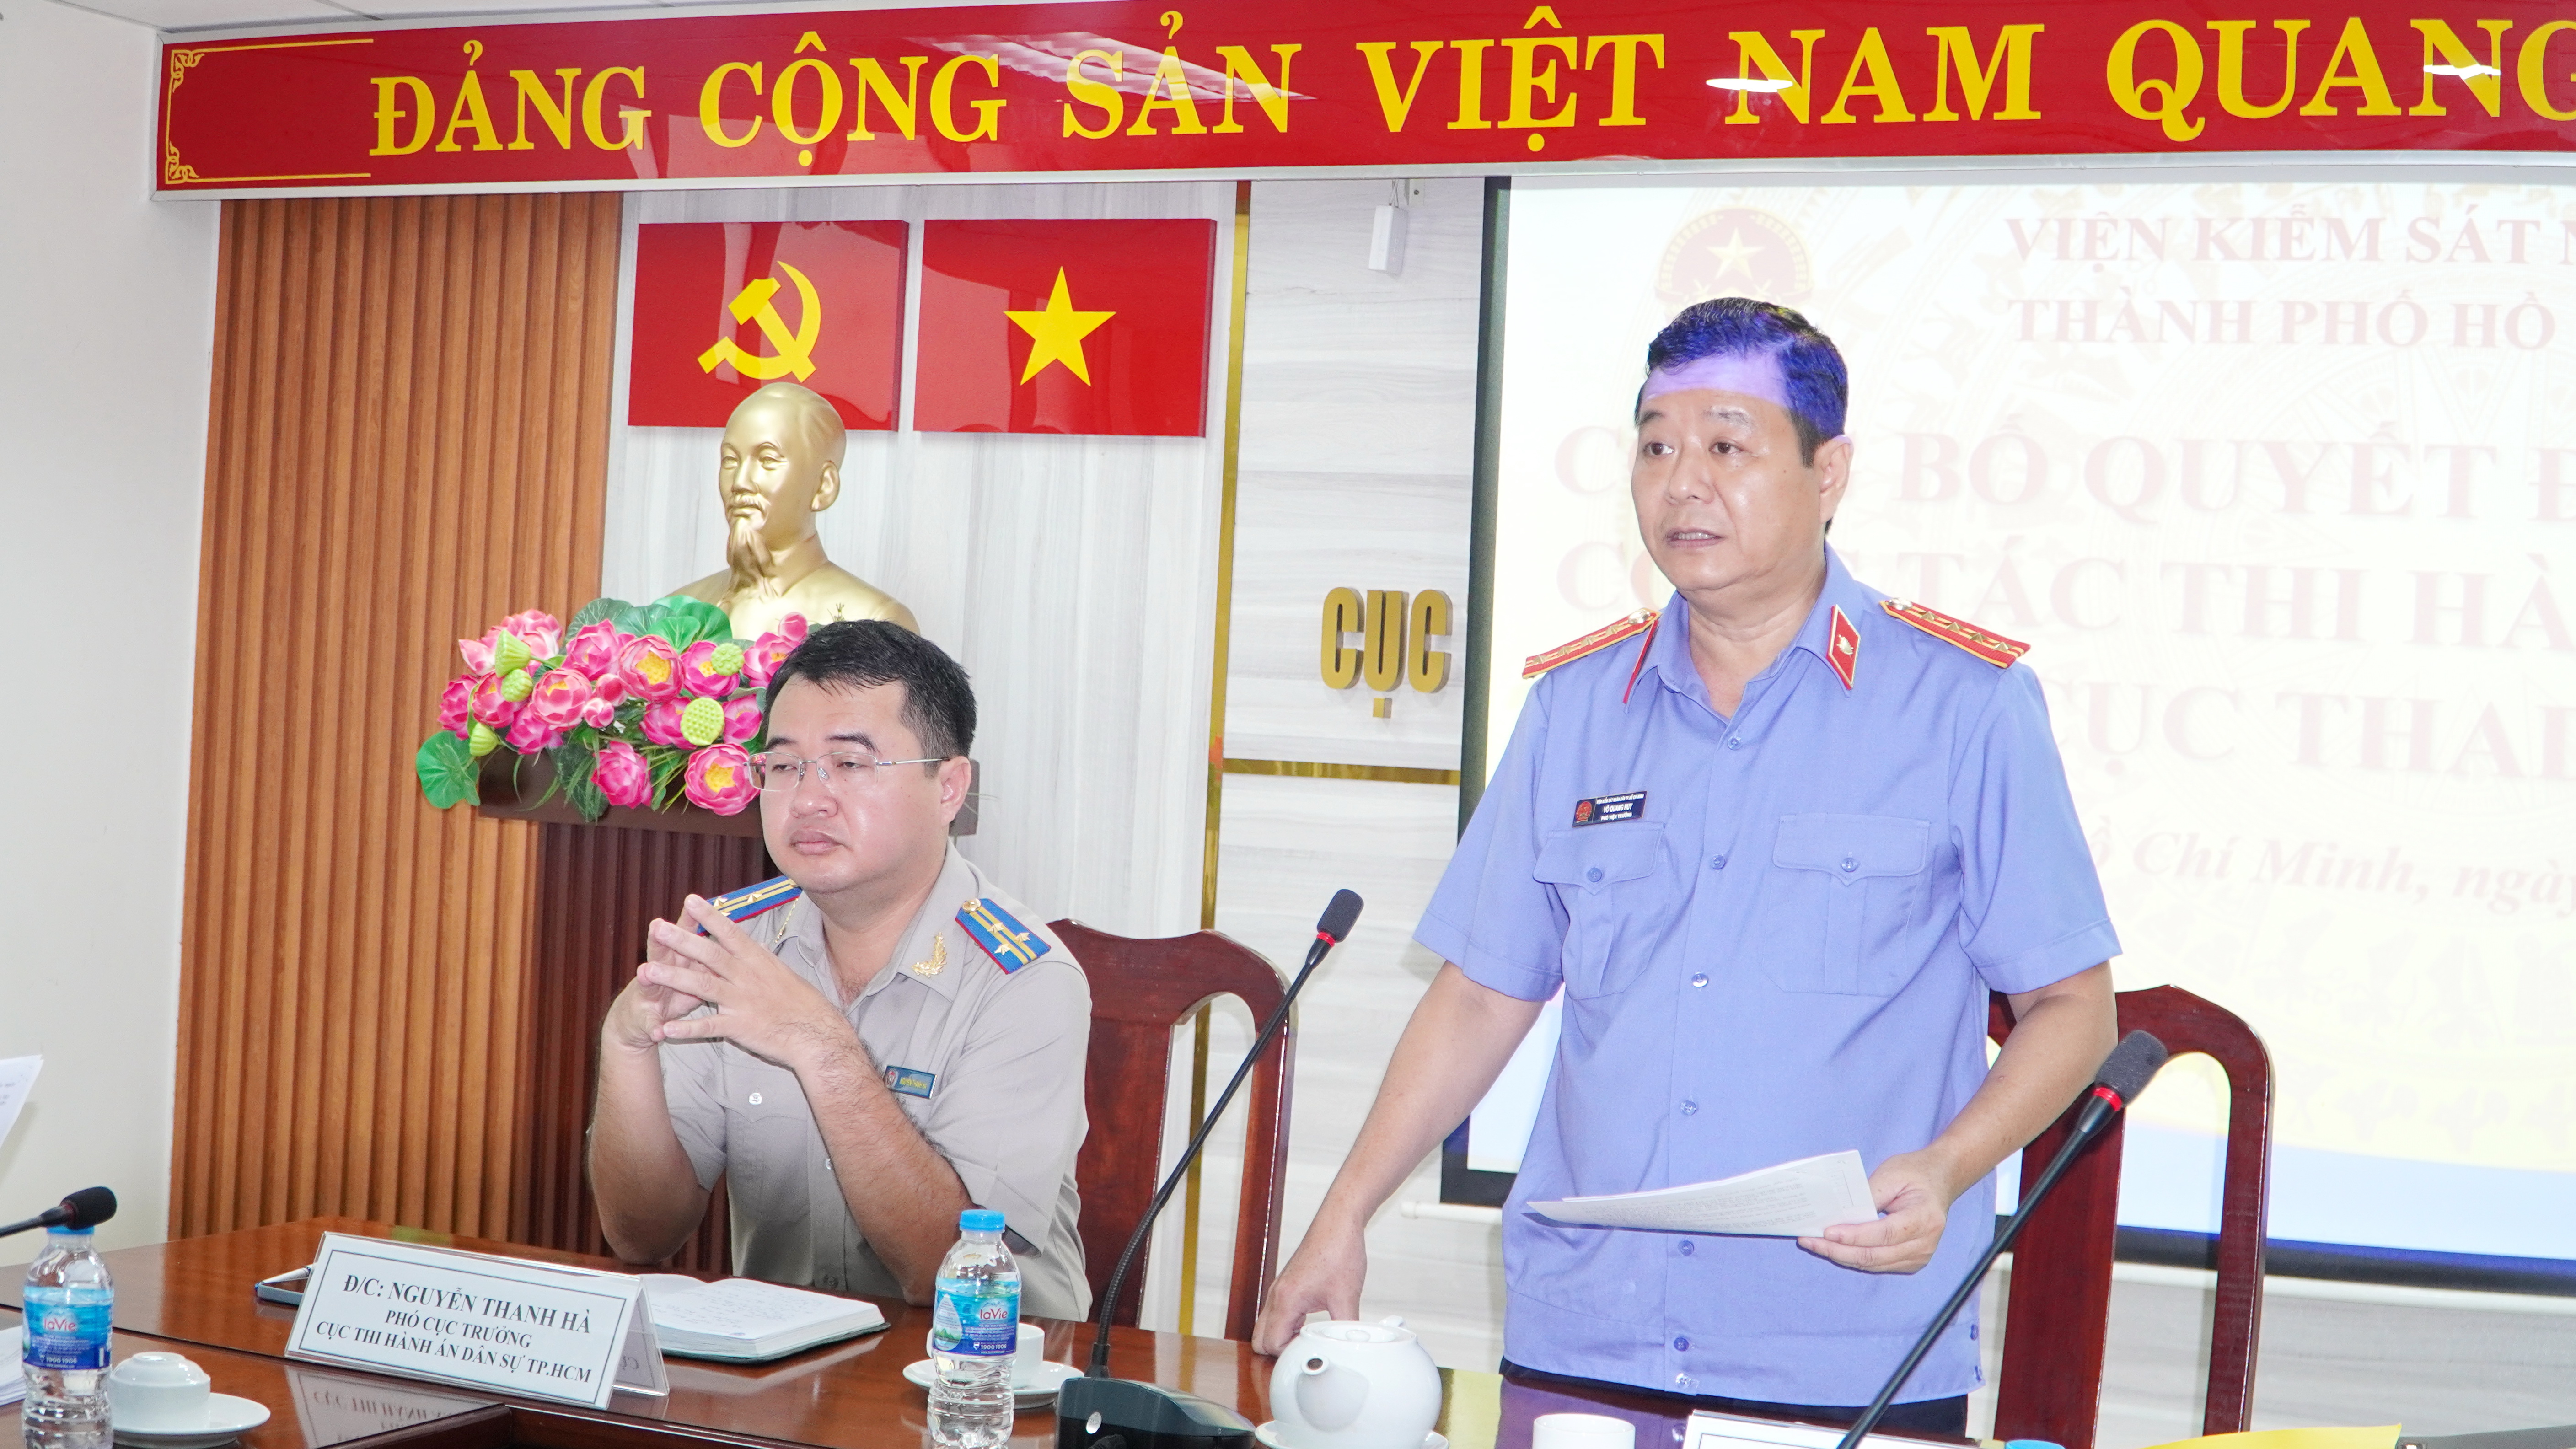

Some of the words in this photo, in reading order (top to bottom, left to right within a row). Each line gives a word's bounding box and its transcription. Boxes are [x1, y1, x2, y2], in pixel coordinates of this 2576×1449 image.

[370, 40, 652, 155] ĐẢNG
[700, 32, 1007, 166] CỘNG
[1063, 11, 1302, 139] SẢN
[1356, 6, 1664, 151] VIỆT
[1725, 24, 2045, 124] NAM
[2107, 17, 2576, 141] QUANG
[2003, 211, 2173, 274] VIỆN
[2405, 204, 2541, 264] SÁT
[2008, 285, 2257, 344] THÀNH
[2276, 289, 2428, 347] PHỐ
[2449, 291, 2555, 350] HỒ
[1890, 413, 2048, 504] BỐ
[2084, 421, 2497, 525] QUYẾT
[1897, 535, 2125, 630] TÁC
[2160, 561, 2370, 642] THI
[1321, 587, 1453, 718] CỤC
[1610, 805, 1624, 813] QUANG
[2133, 831, 2242, 881] Chí
[2248, 838, 2429, 905] Minh,
[44, 1318, 76, 1331] laVie
[343, 1274, 384, 1297] Đ/C:
[387, 1282, 478, 1313] NGUYỄN
[482, 1298, 558, 1327] THANH
[560, 1309, 590, 1333] HÀ
[385, 1309, 419, 1328] PHÓ
[423, 1317, 458, 1336] CỤC
[462, 1323, 532, 1348] TRƯỞNG
[980, 1308, 1008, 1320] laVie
[317, 1321, 350, 1340] CỤC
[354, 1327, 382, 1345] THI
[384, 1331, 433, 1354] HÀNH
[434, 1338, 460, 1358] ÁN
[461, 1345, 497, 1365] DÂN
[499, 1354, 526, 1373] SỰ
[527, 1358, 592, 1383] TP.HCM
